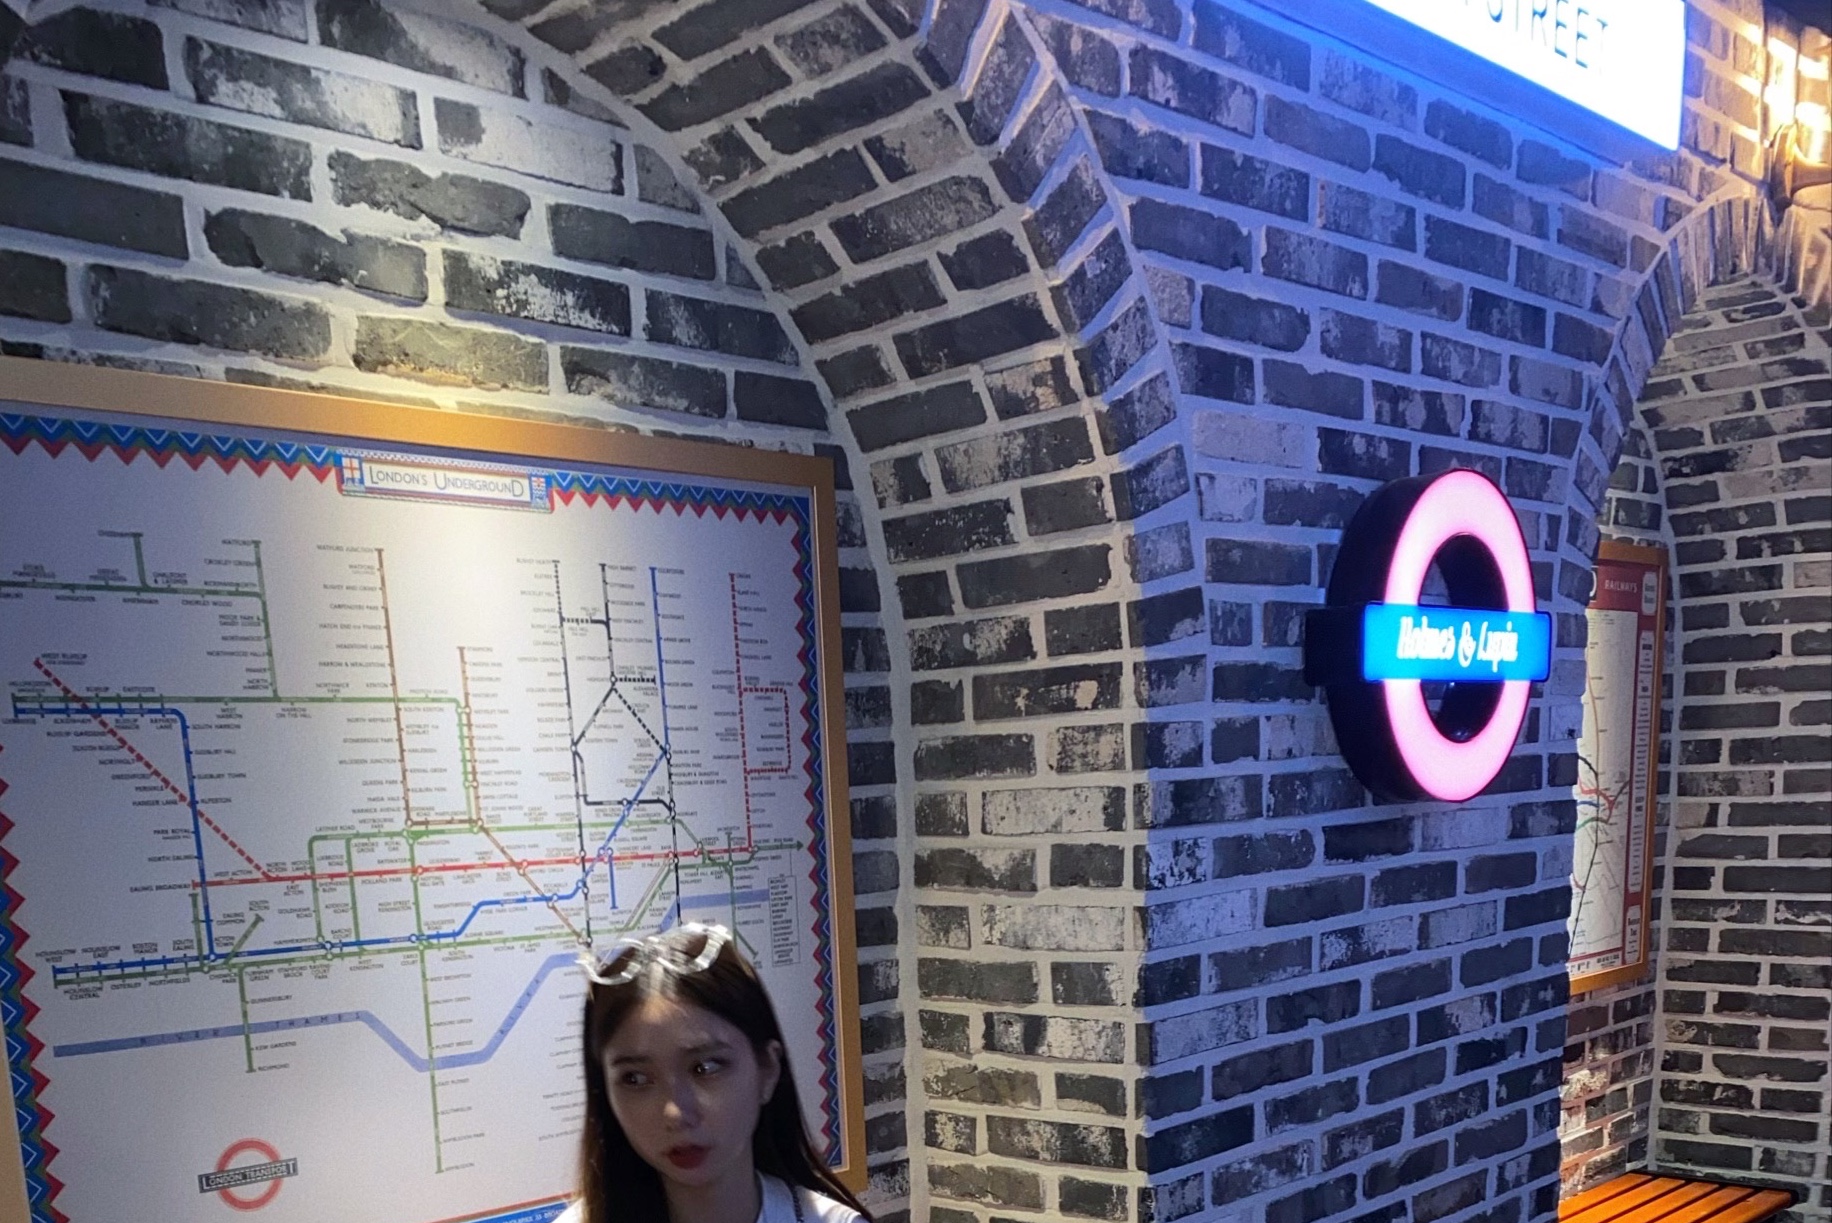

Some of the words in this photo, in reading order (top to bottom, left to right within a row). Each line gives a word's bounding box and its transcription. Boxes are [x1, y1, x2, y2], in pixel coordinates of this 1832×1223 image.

[369, 465, 428, 486] LONDON'S
[434, 473, 525, 498] UNDERGROUND
[1604, 579, 1638, 593] RAILWAYS
[1396, 616, 1456, 660] Holmes
[1457, 621, 1476, 668] &
[1477, 621, 1518, 673] Lupin
[202, 1175, 243, 1189] LONDON
[246, 1161, 295, 1179] TRANSPORT
